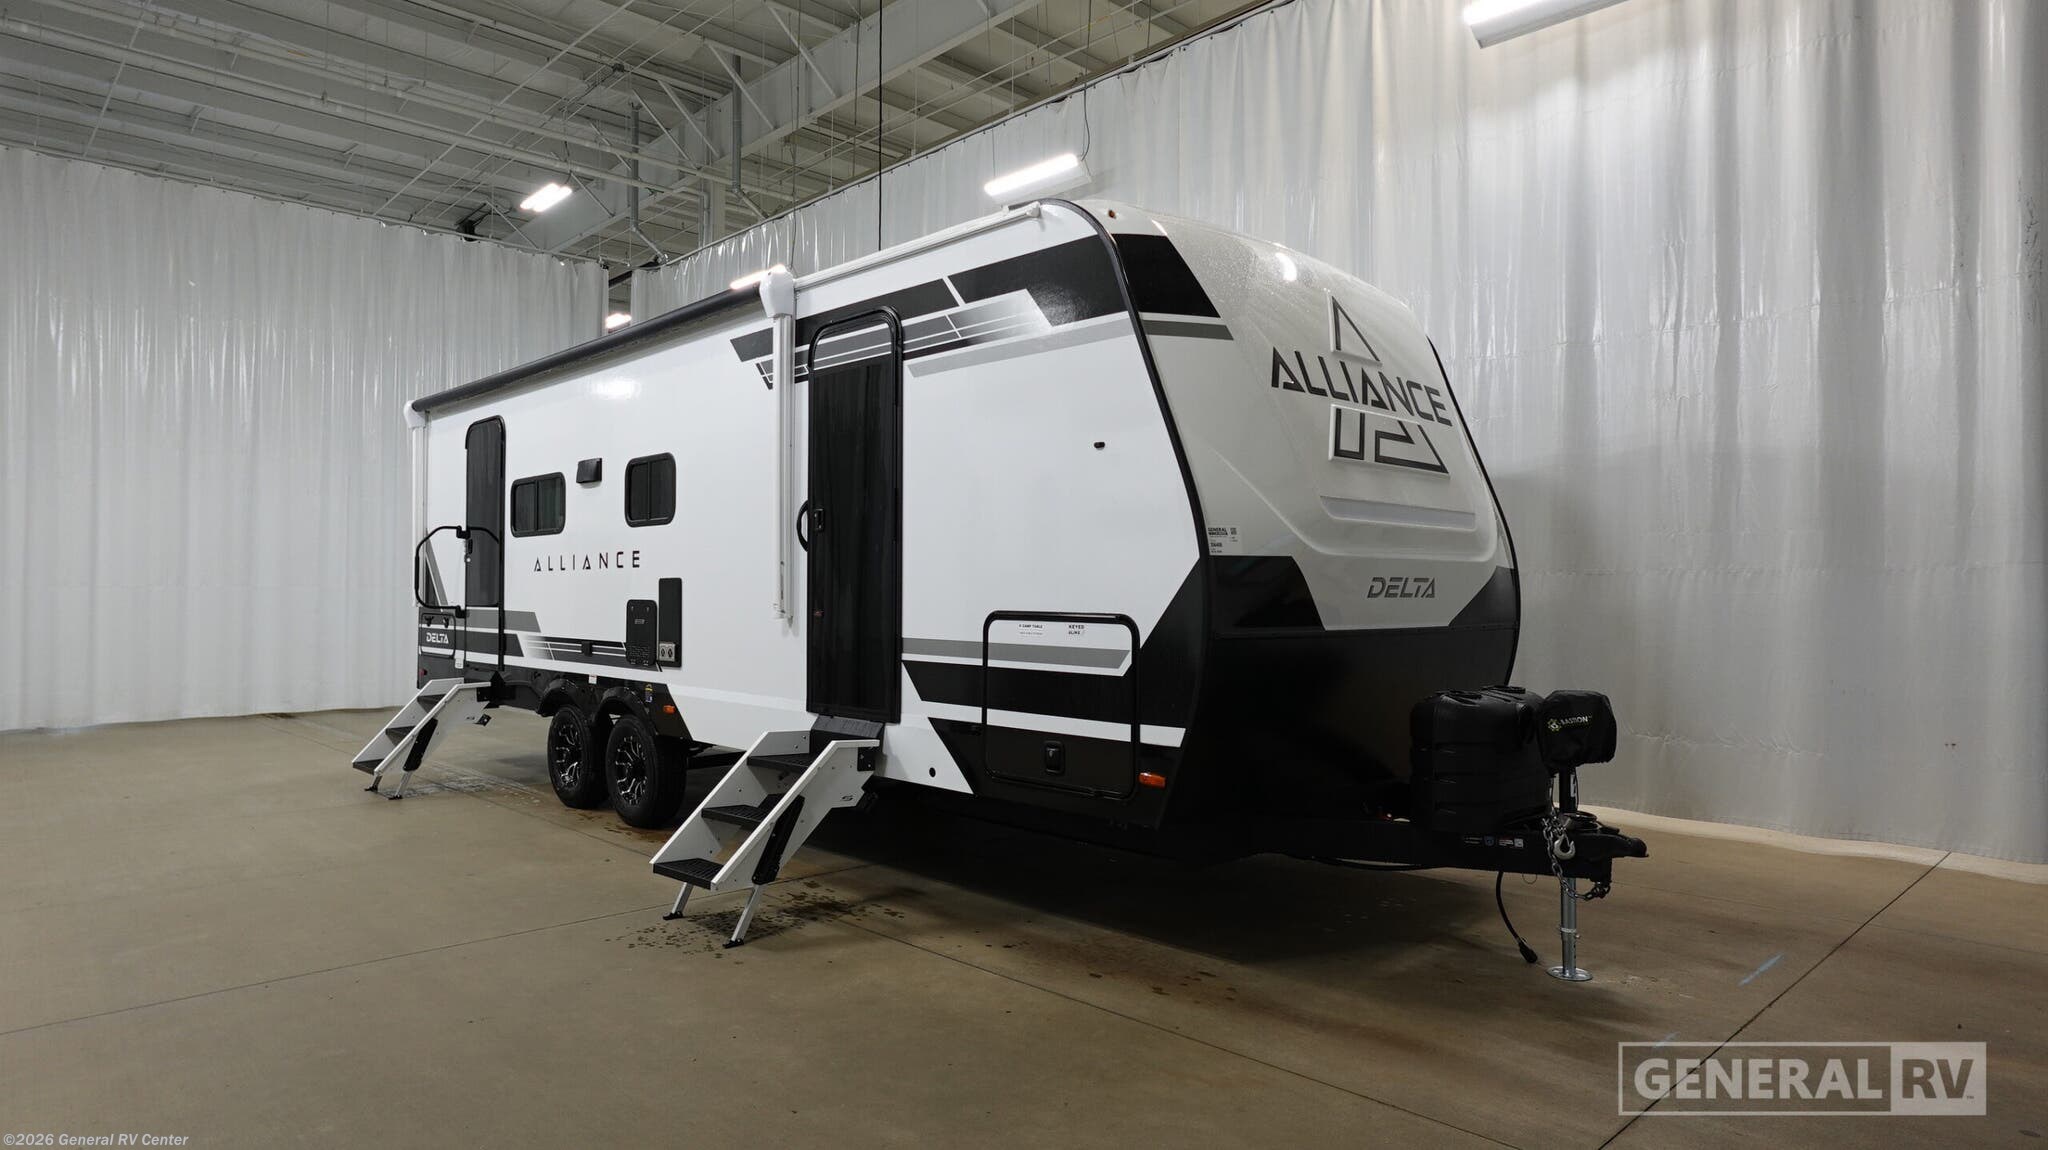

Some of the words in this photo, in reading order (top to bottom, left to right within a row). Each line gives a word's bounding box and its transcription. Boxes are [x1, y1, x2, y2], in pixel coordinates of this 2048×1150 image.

[1271, 346, 1452, 426] ALLIANCE
[534, 550, 640, 572] ALLIANCE
[1367, 577, 1435, 599] DELTA
[426, 632, 449, 644] DELTA
